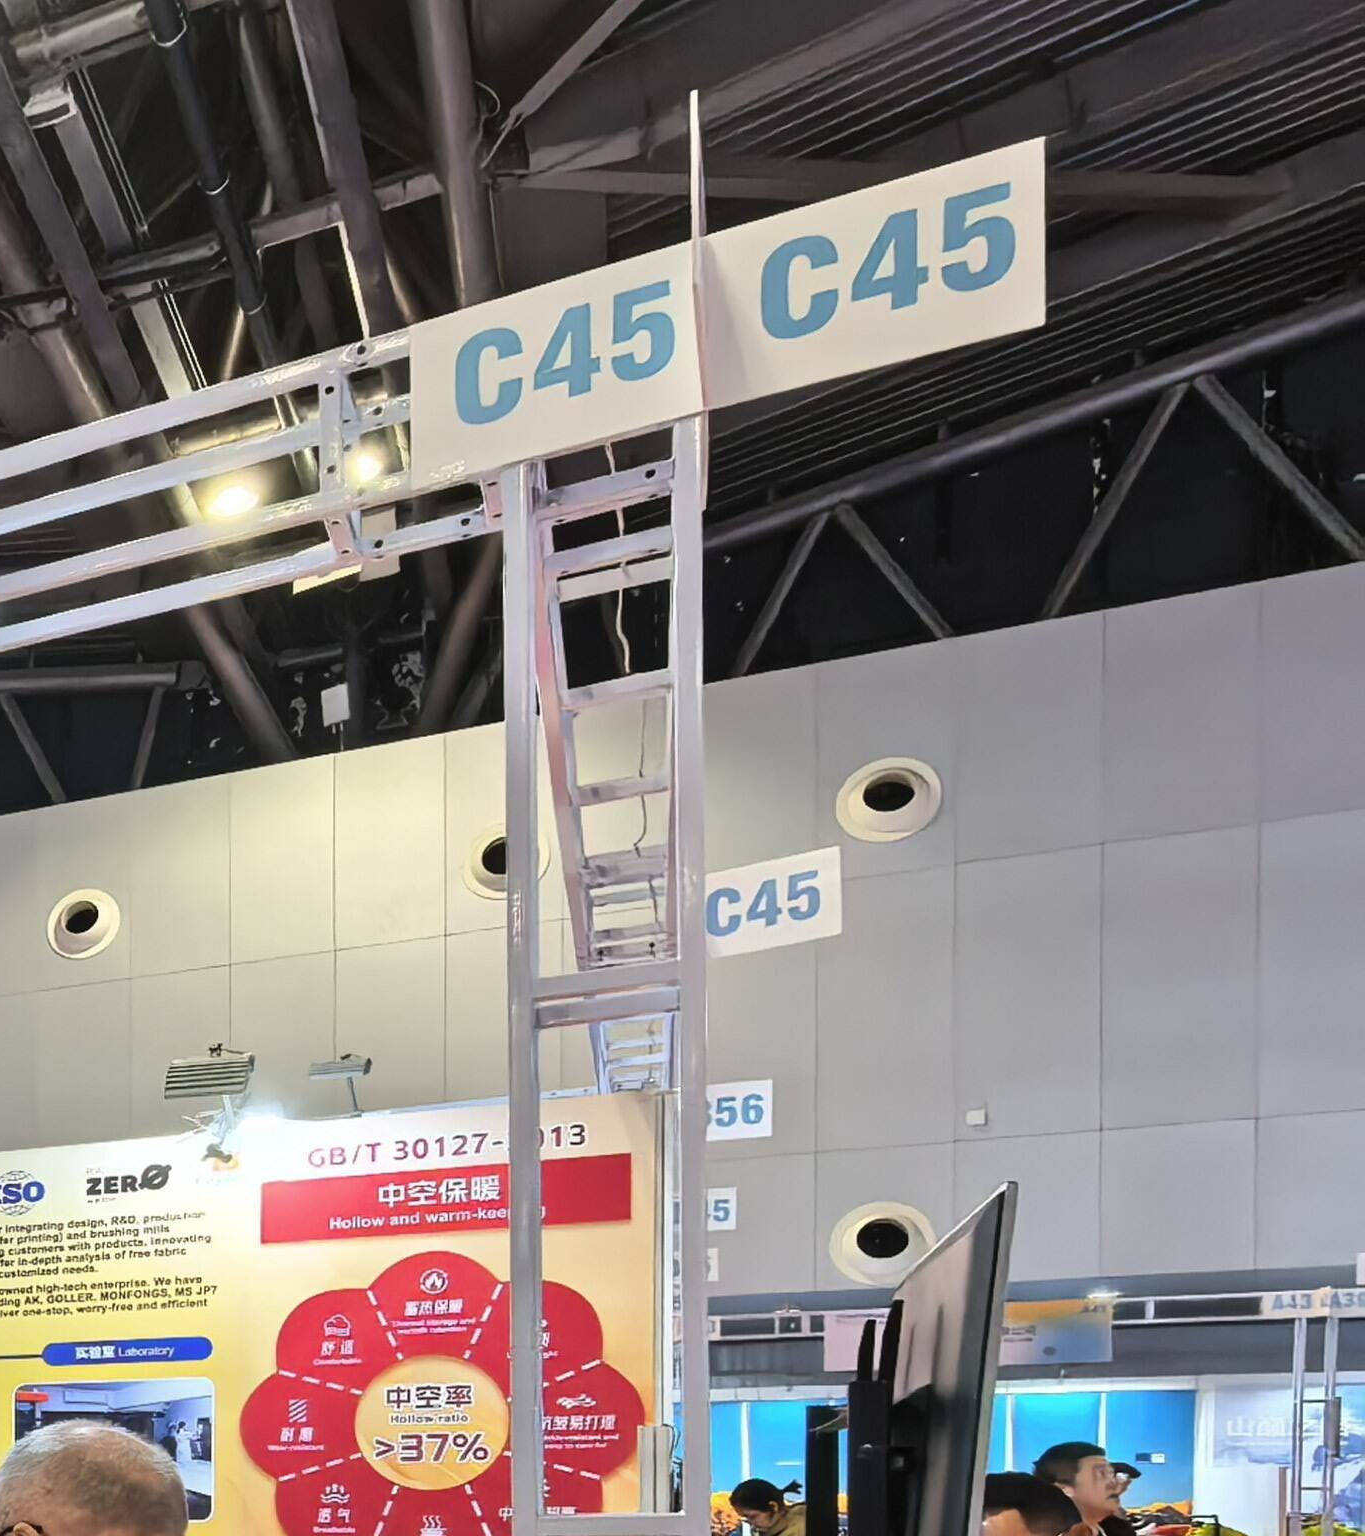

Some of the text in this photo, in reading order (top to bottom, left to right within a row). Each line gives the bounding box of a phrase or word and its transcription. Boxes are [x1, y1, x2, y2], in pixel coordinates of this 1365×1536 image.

[760, 181, 1018, 340] C45
[454, 279, 677, 426] C45
[705, 869, 821, 937] C45
[308, 1124, 586, 1168] GB/T 30127-13
[378, 1175, 501, 1208] 中空保暖
[5, 1221, 64, 1234] integrating
[329, 1215, 384, 1230] Hollow
[390, 1211, 420, 1226] and
[8, 1245, 65, 1256] customers
[68, 1241, 91, 1251] with
[150, 1234, 212, 1246] innovating
[17, 1232, 64, 1245] printing)
[66, 1230, 87, 1240] and
[90, 1226, 140, 1239] brushing
[18, 1254, 63, 1267] in-depth
[65, 1251, 111, 1264] analysis
[129, 1250, 151, 1259] free
[154, 1247, 187, 1258] fabric
[62, 1264, 99, 1275] needs.
[36, 1281, 88, 1295] high-tech
[90, 1278, 151, 1291] enterprise.
[153, 1276, 172, 1287] We
[174, 1275, 203, 1286] have
[175, 1286, 193, 1297] MS
[195, 1285, 219, 1296] JP7
[76, 1302, 134, 1315] worry-free
[136, 1300, 158, 1311] and
[160, 1298, 208, 1310] efficient
[118, 1345, 175, 1359] Laboratory
[385, 1385, 474, 1412] 中空率
[390, 1411, 469, 1425] Hollow ratio
[373, 1432, 490, 1464] >37%
